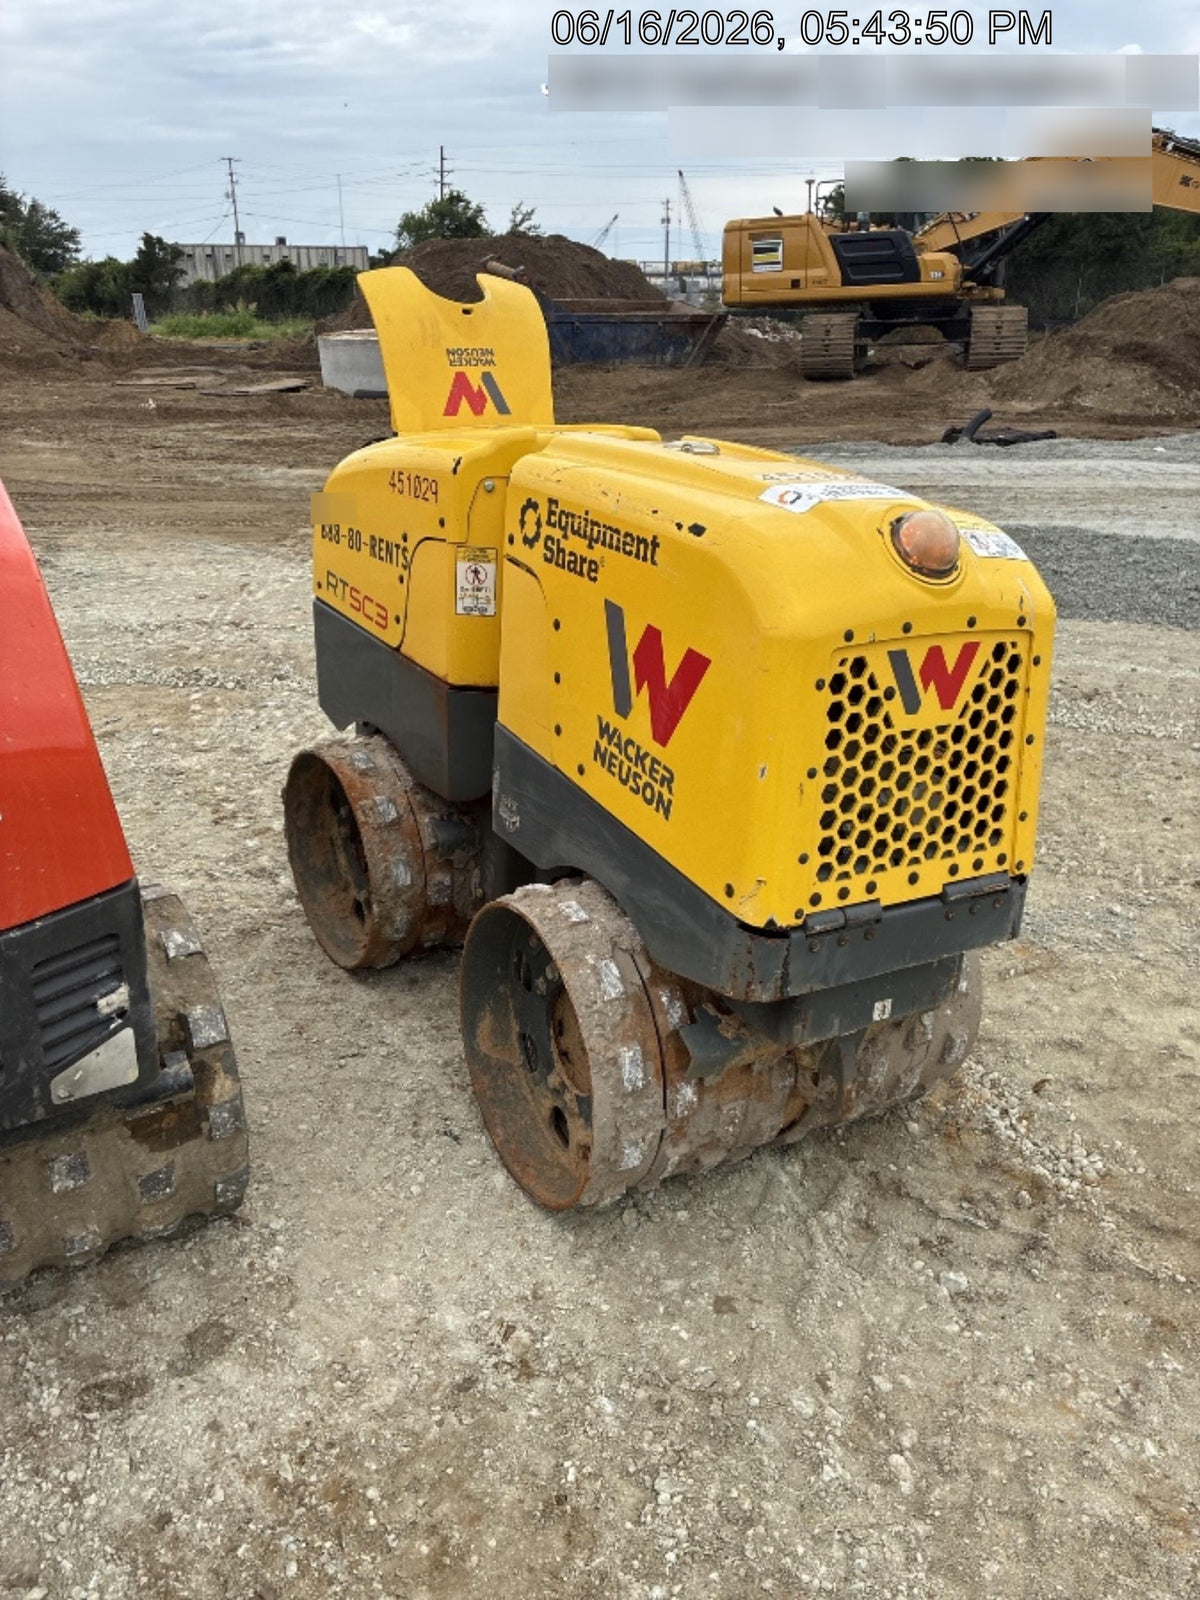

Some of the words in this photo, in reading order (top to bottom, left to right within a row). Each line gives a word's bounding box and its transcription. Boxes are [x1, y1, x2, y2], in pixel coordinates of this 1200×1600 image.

[446, 348, 495, 358] NEUSON
[449, 357, 496, 367] WACKER
[389, 470, 439, 503] 451029
[546, 497, 660, 567] Equipment
[543, 534, 599, 583] Share
[597, 714, 675, 795] WACKER
[593, 739, 672, 822] NEUSON
